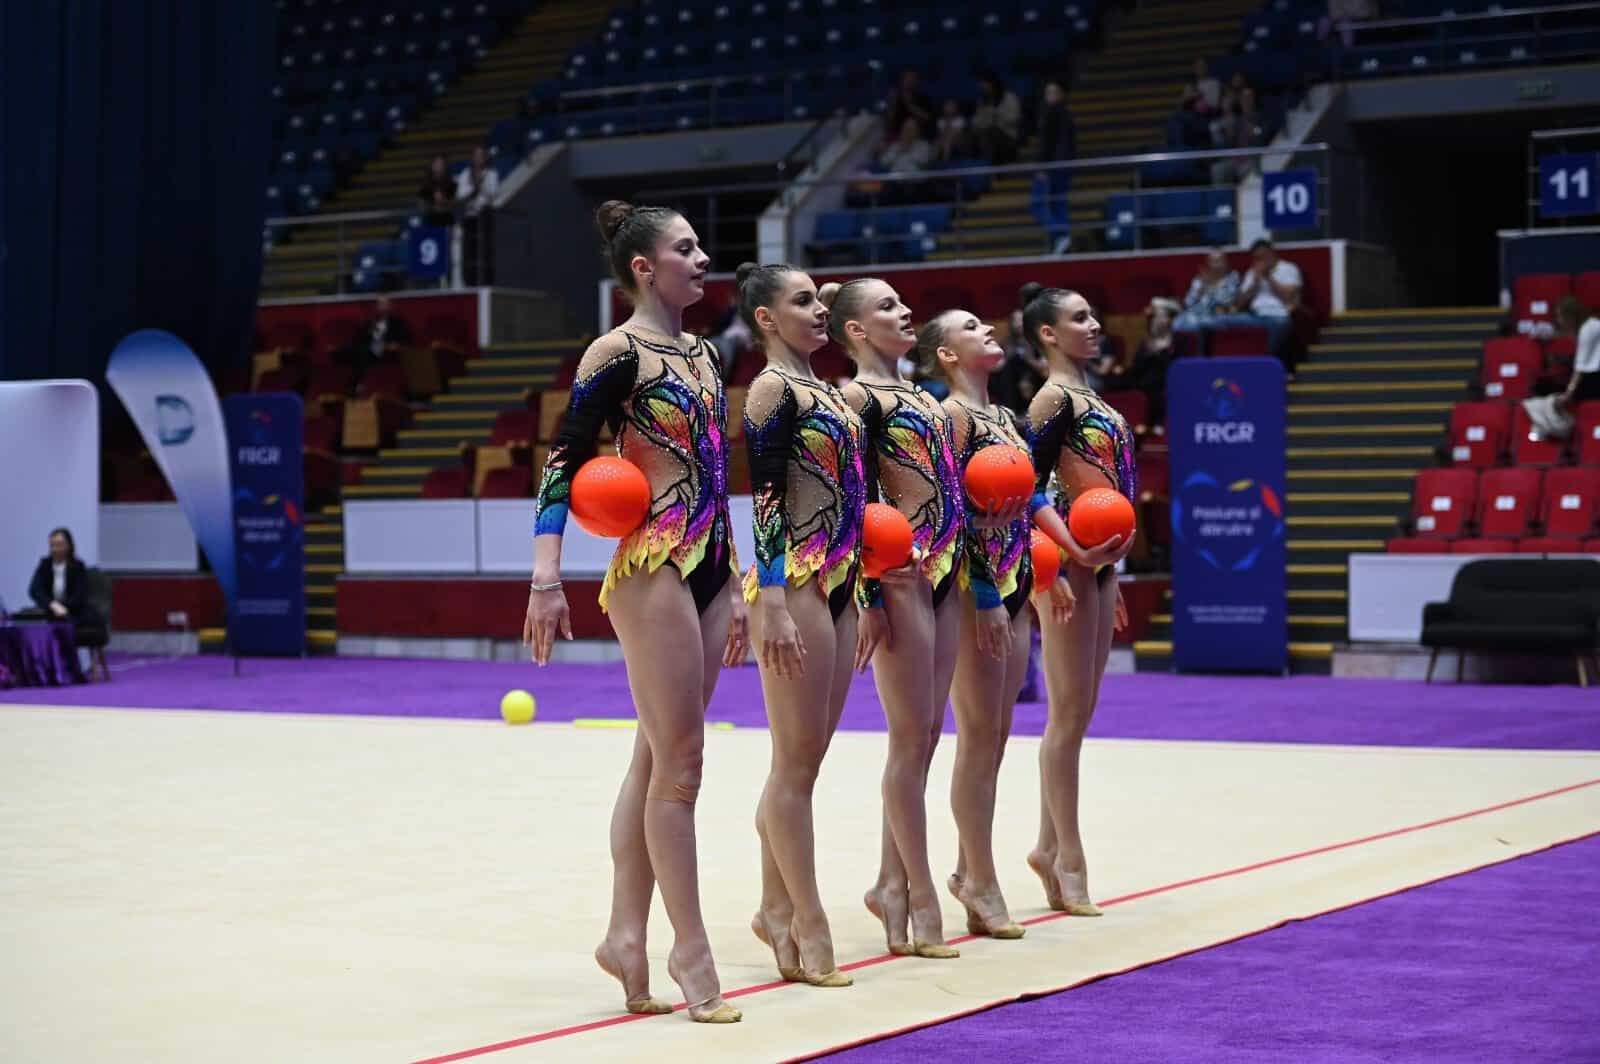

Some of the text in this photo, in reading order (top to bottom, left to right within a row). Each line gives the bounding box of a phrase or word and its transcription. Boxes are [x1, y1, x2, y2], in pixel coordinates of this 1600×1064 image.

[1549, 168, 1590, 199] 11
[1267, 183, 1309, 214] 10
[420, 238, 438, 265] 9
[1195, 422, 1254, 442] FRGR
